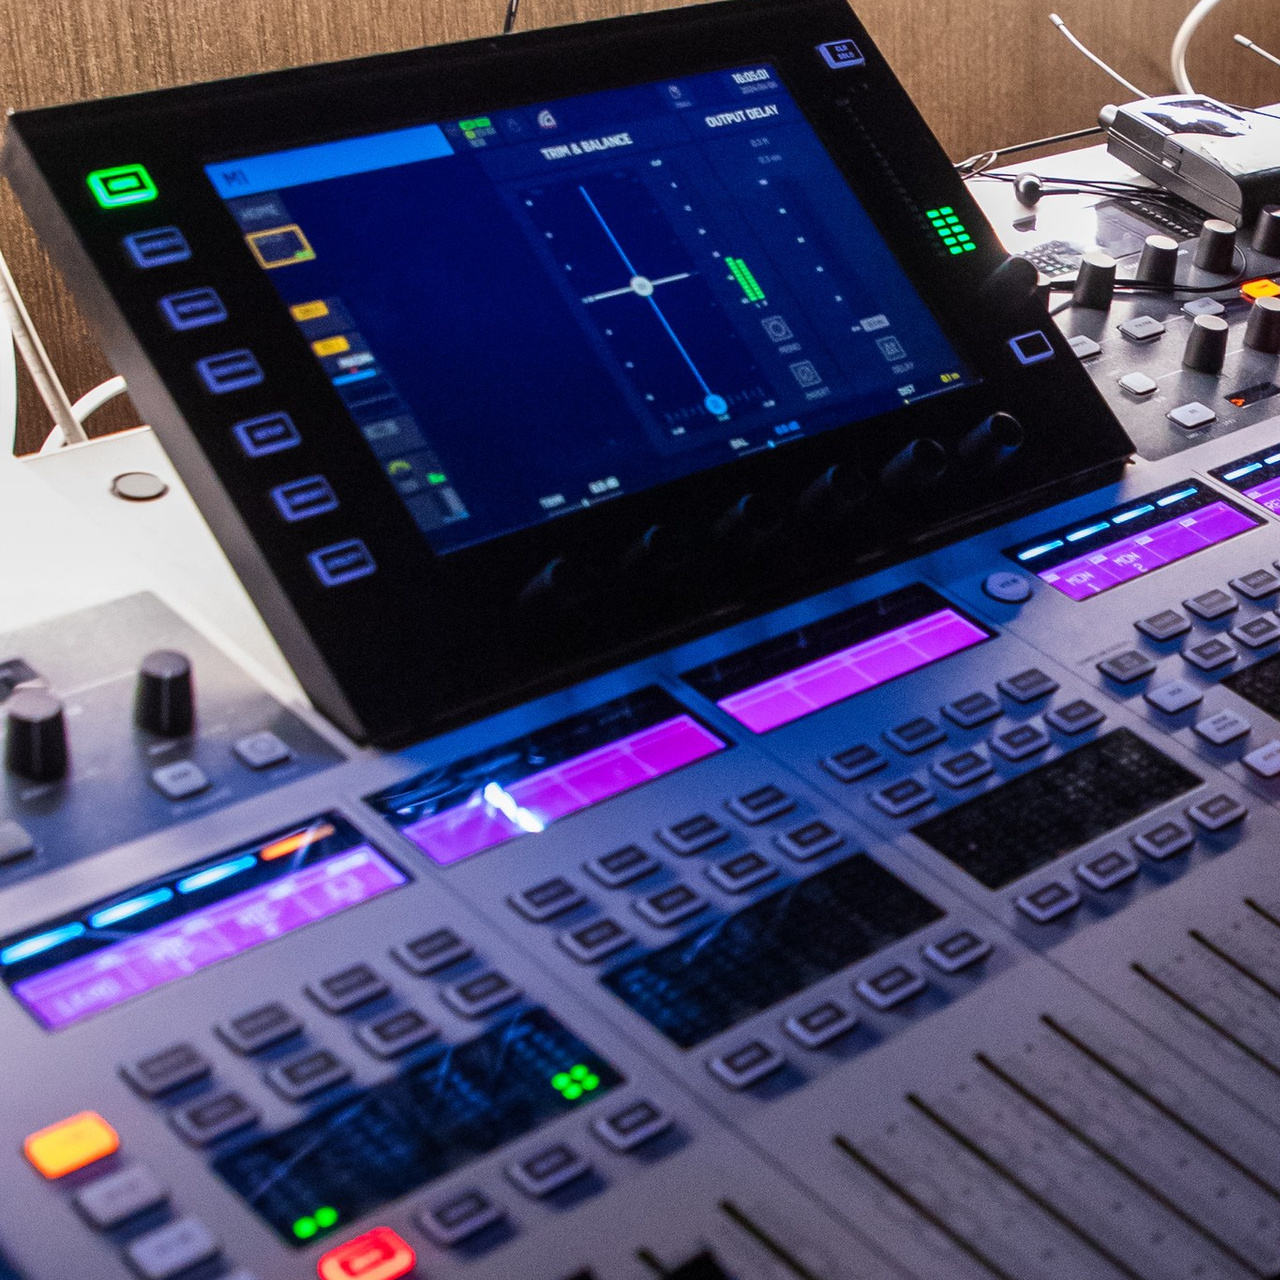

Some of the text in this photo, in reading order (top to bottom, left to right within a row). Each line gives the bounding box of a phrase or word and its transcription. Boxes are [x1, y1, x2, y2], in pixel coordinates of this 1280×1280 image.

[705, 104, 779, 128] OUTPUT DELAY
[540, 132, 634, 160] TRIM & BALANCE
[1113, 551, 1141, 567] MON
[1065, 571, 1095, 586] MON
